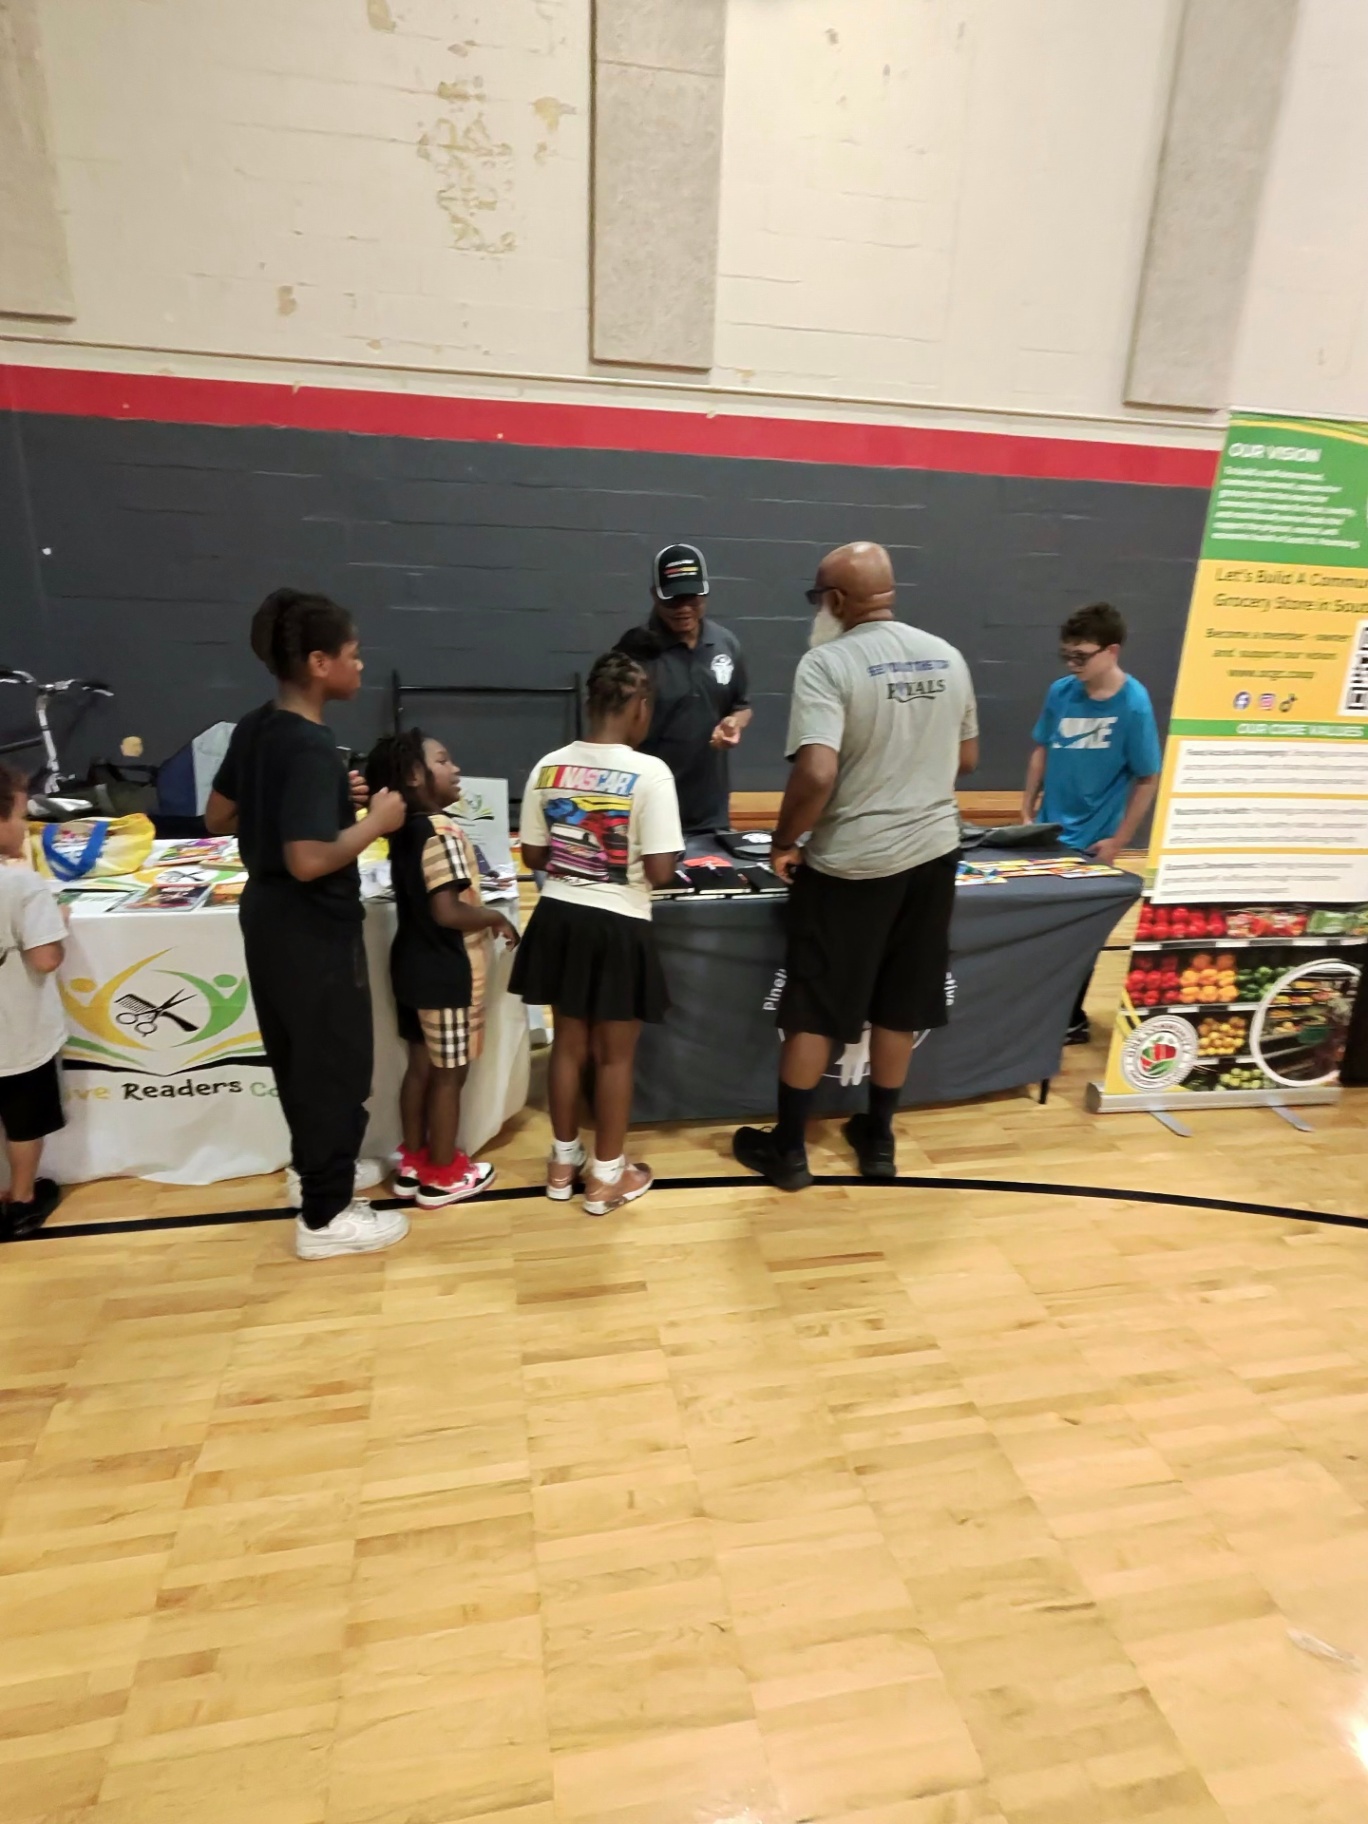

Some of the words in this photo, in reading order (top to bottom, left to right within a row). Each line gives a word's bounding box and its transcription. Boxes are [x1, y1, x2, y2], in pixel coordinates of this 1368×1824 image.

[1229, 442, 1264, 458] OUR
[1213, 593, 1271, 612] Grocery
[1275, 596, 1314, 610] Store
[1236, 723, 1268, 734] OUR
[1269, 724, 1308, 736] CORE
[1309, 725, 1365, 738] VALUES
[558, 765, 634, 796] NASCAR
[121, 1079, 244, 1101] Readers
